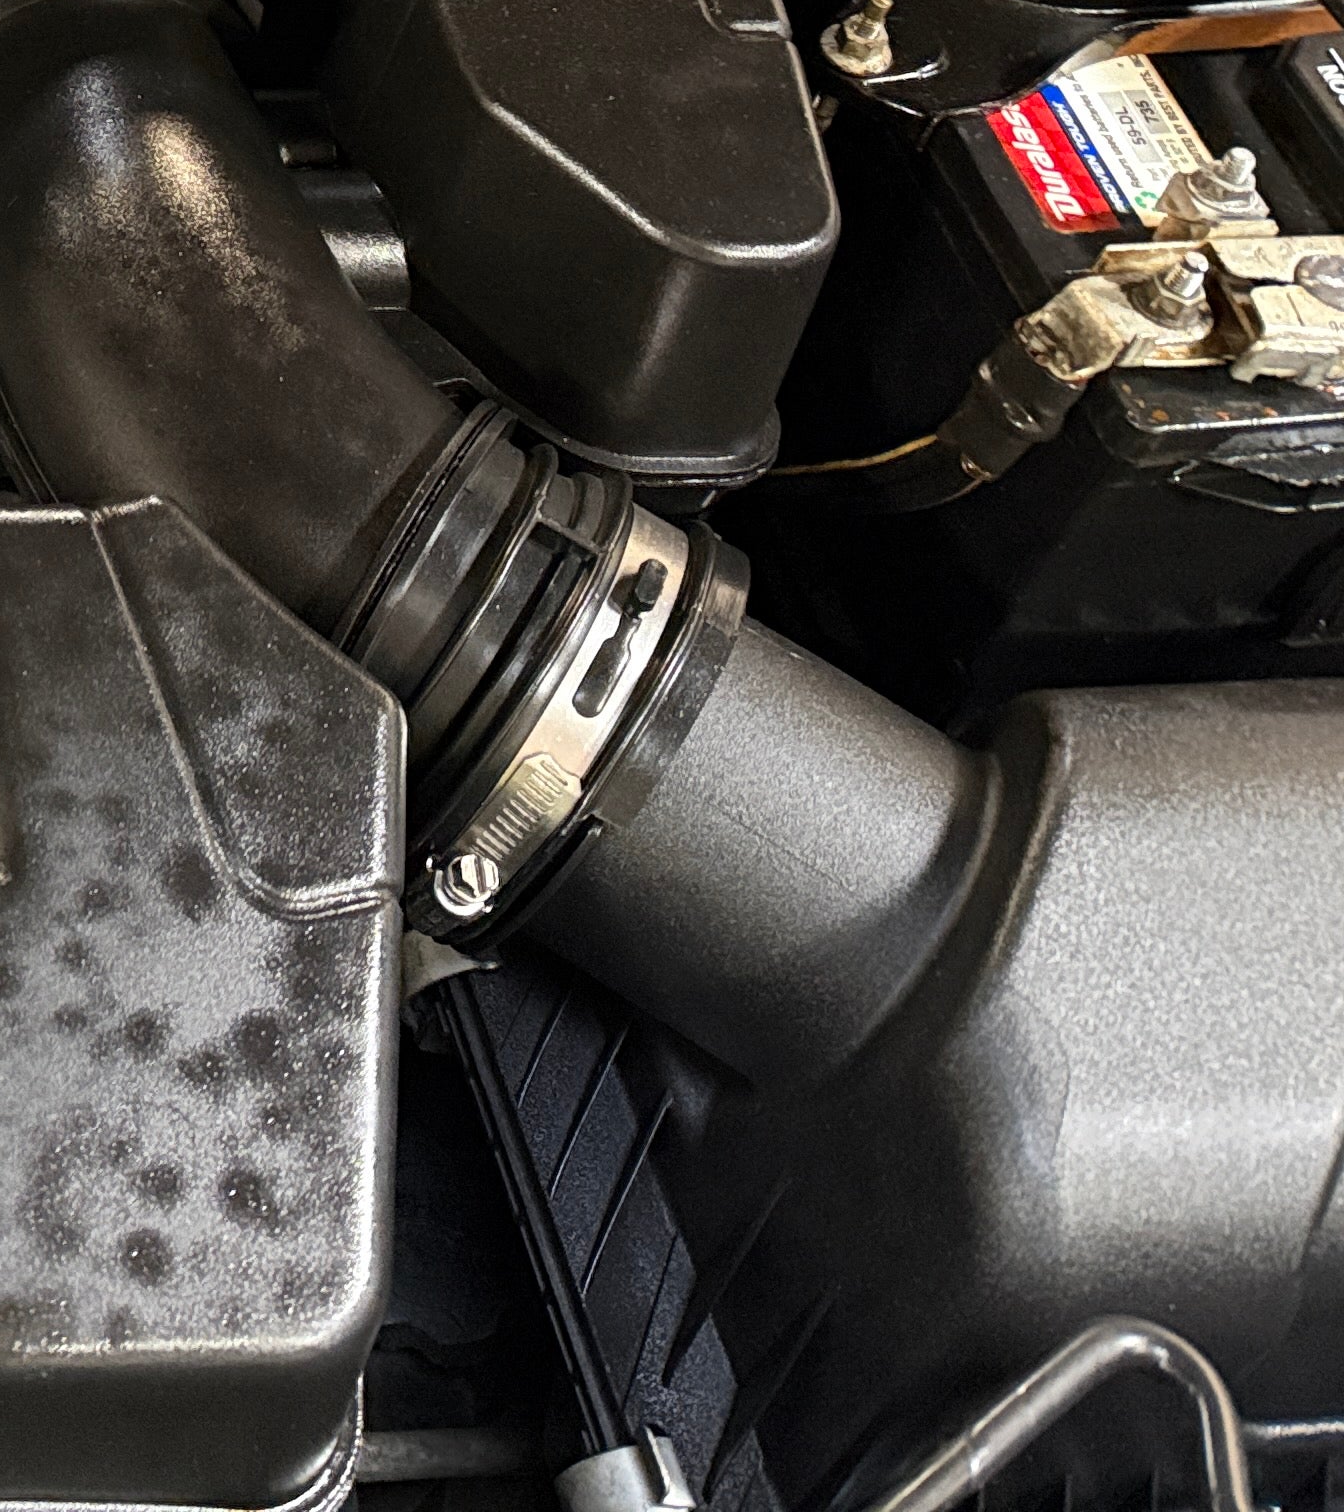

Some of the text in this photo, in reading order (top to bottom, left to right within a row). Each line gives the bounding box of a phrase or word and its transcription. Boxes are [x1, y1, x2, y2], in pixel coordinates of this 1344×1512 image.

[1050, 100, 1091, 158] TOUGH
[1115, 106, 1147, 146] 59-DL
[1135, 100, 1160, 124] 735
